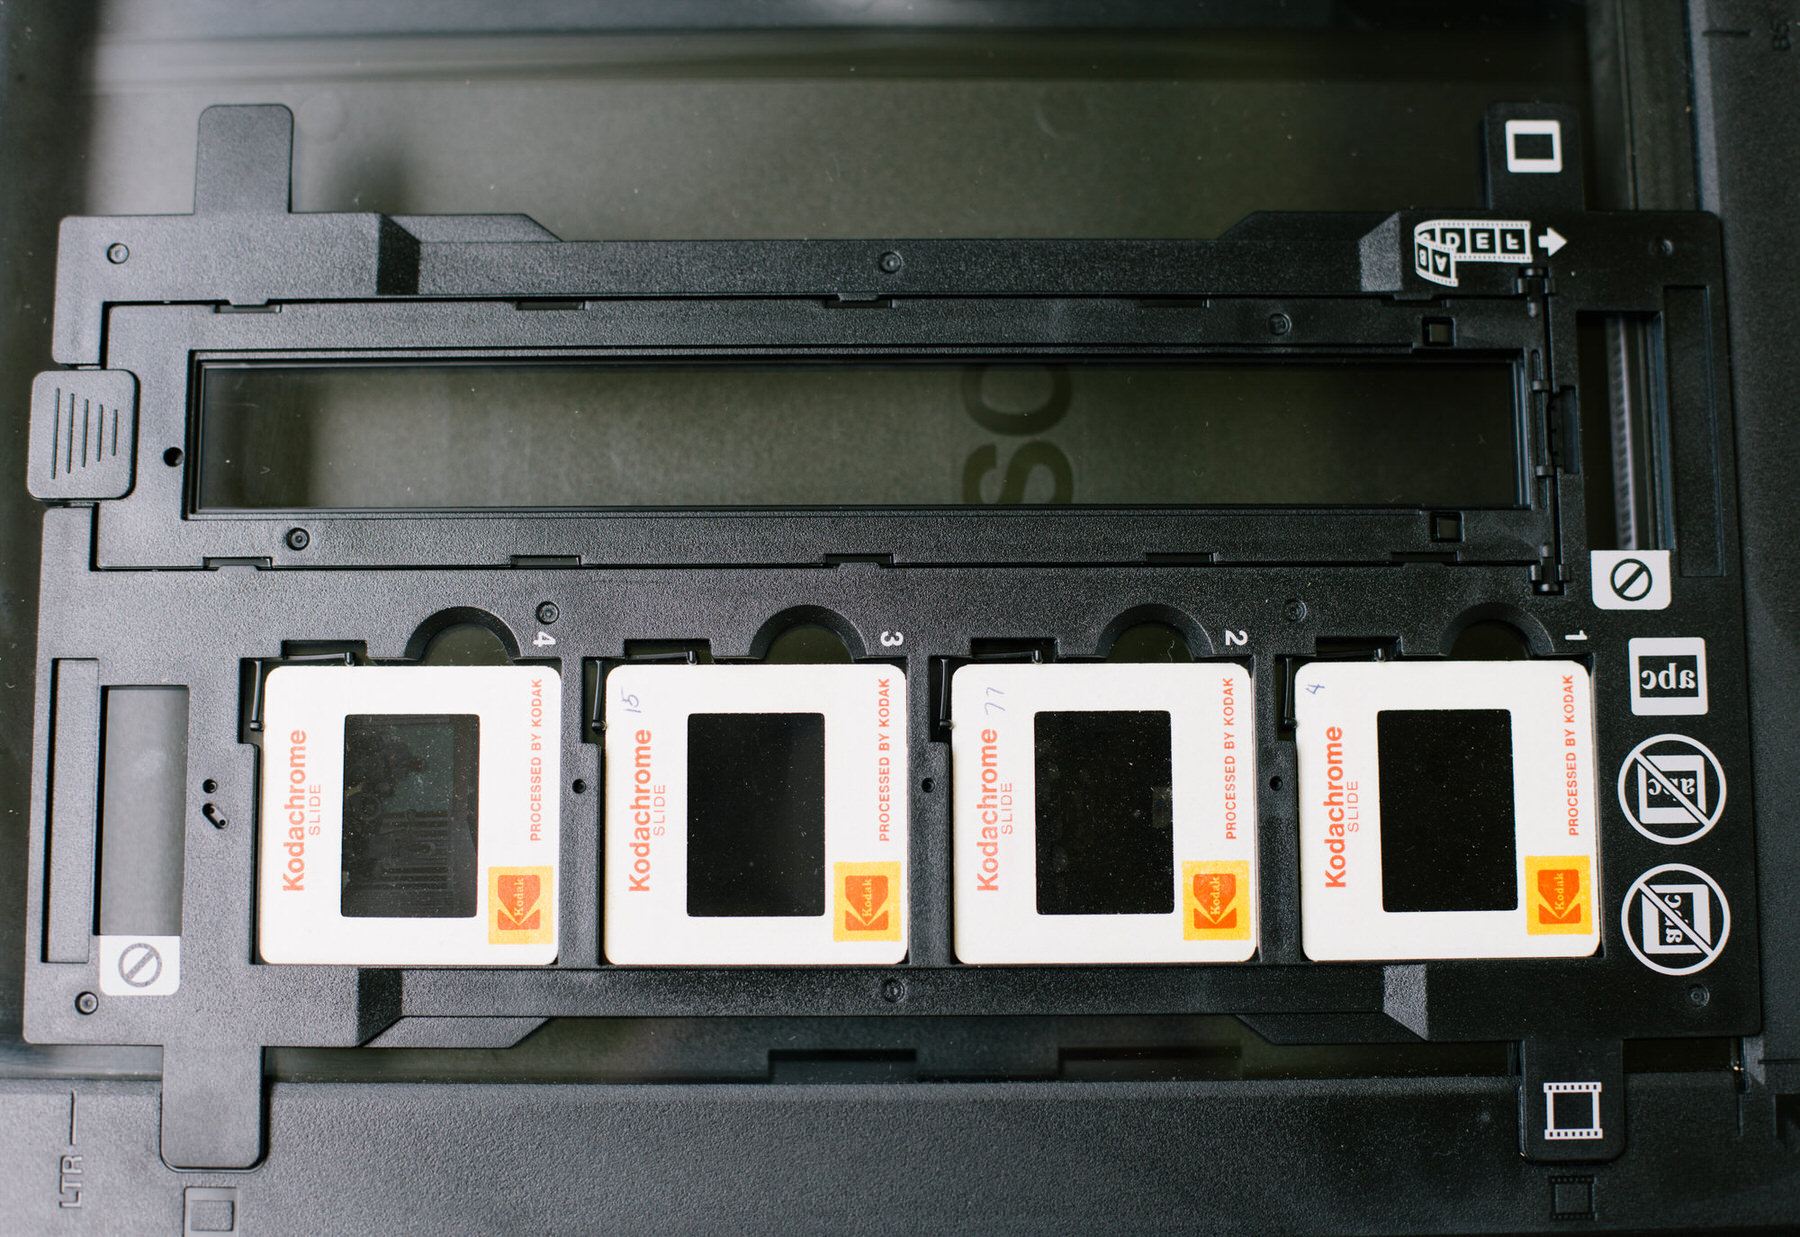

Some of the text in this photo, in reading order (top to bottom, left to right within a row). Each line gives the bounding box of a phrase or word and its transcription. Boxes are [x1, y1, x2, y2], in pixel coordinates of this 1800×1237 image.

[533, 630, 557, 648] 4
[880, 630, 904, 648] 3
[1225, 629, 1248, 646] 2
[1564, 629, 1588, 641] 1
[1305, 683, 1326, 695] 4
[530, 678, 543, 842] PROCESSED BY KODAK
[878, 677, 890, 842] PROCESSED BY KODAK
[1222, 677, 1237, 840] PROCESSED BY KODAK
[1562, 674, 1579, 836] PROCESSED BY KODAK
[283, 729, 307, 892] Kodachrome
[309, 783, 321, 836] SLIDE
[628, 728, 652, 892] Kodachrome
[653, 783, 666, 837] SLIDE
[976, 728, 999, 891] Kodachrome
[1000, 782, 1013, 835] SLIDE
[1323, 726, 1347, 888] Kodachrome
[1347, 780, 1360, 833] SLIDE
[513, 877, 524, 916] Kodak
[861, 878, 872, 917] Kodak
[1209, 876, 1220, 915] Kodak
[1553, 872, 1565, 910] Kodak
[59, 1154, 83, 1209] LTR
